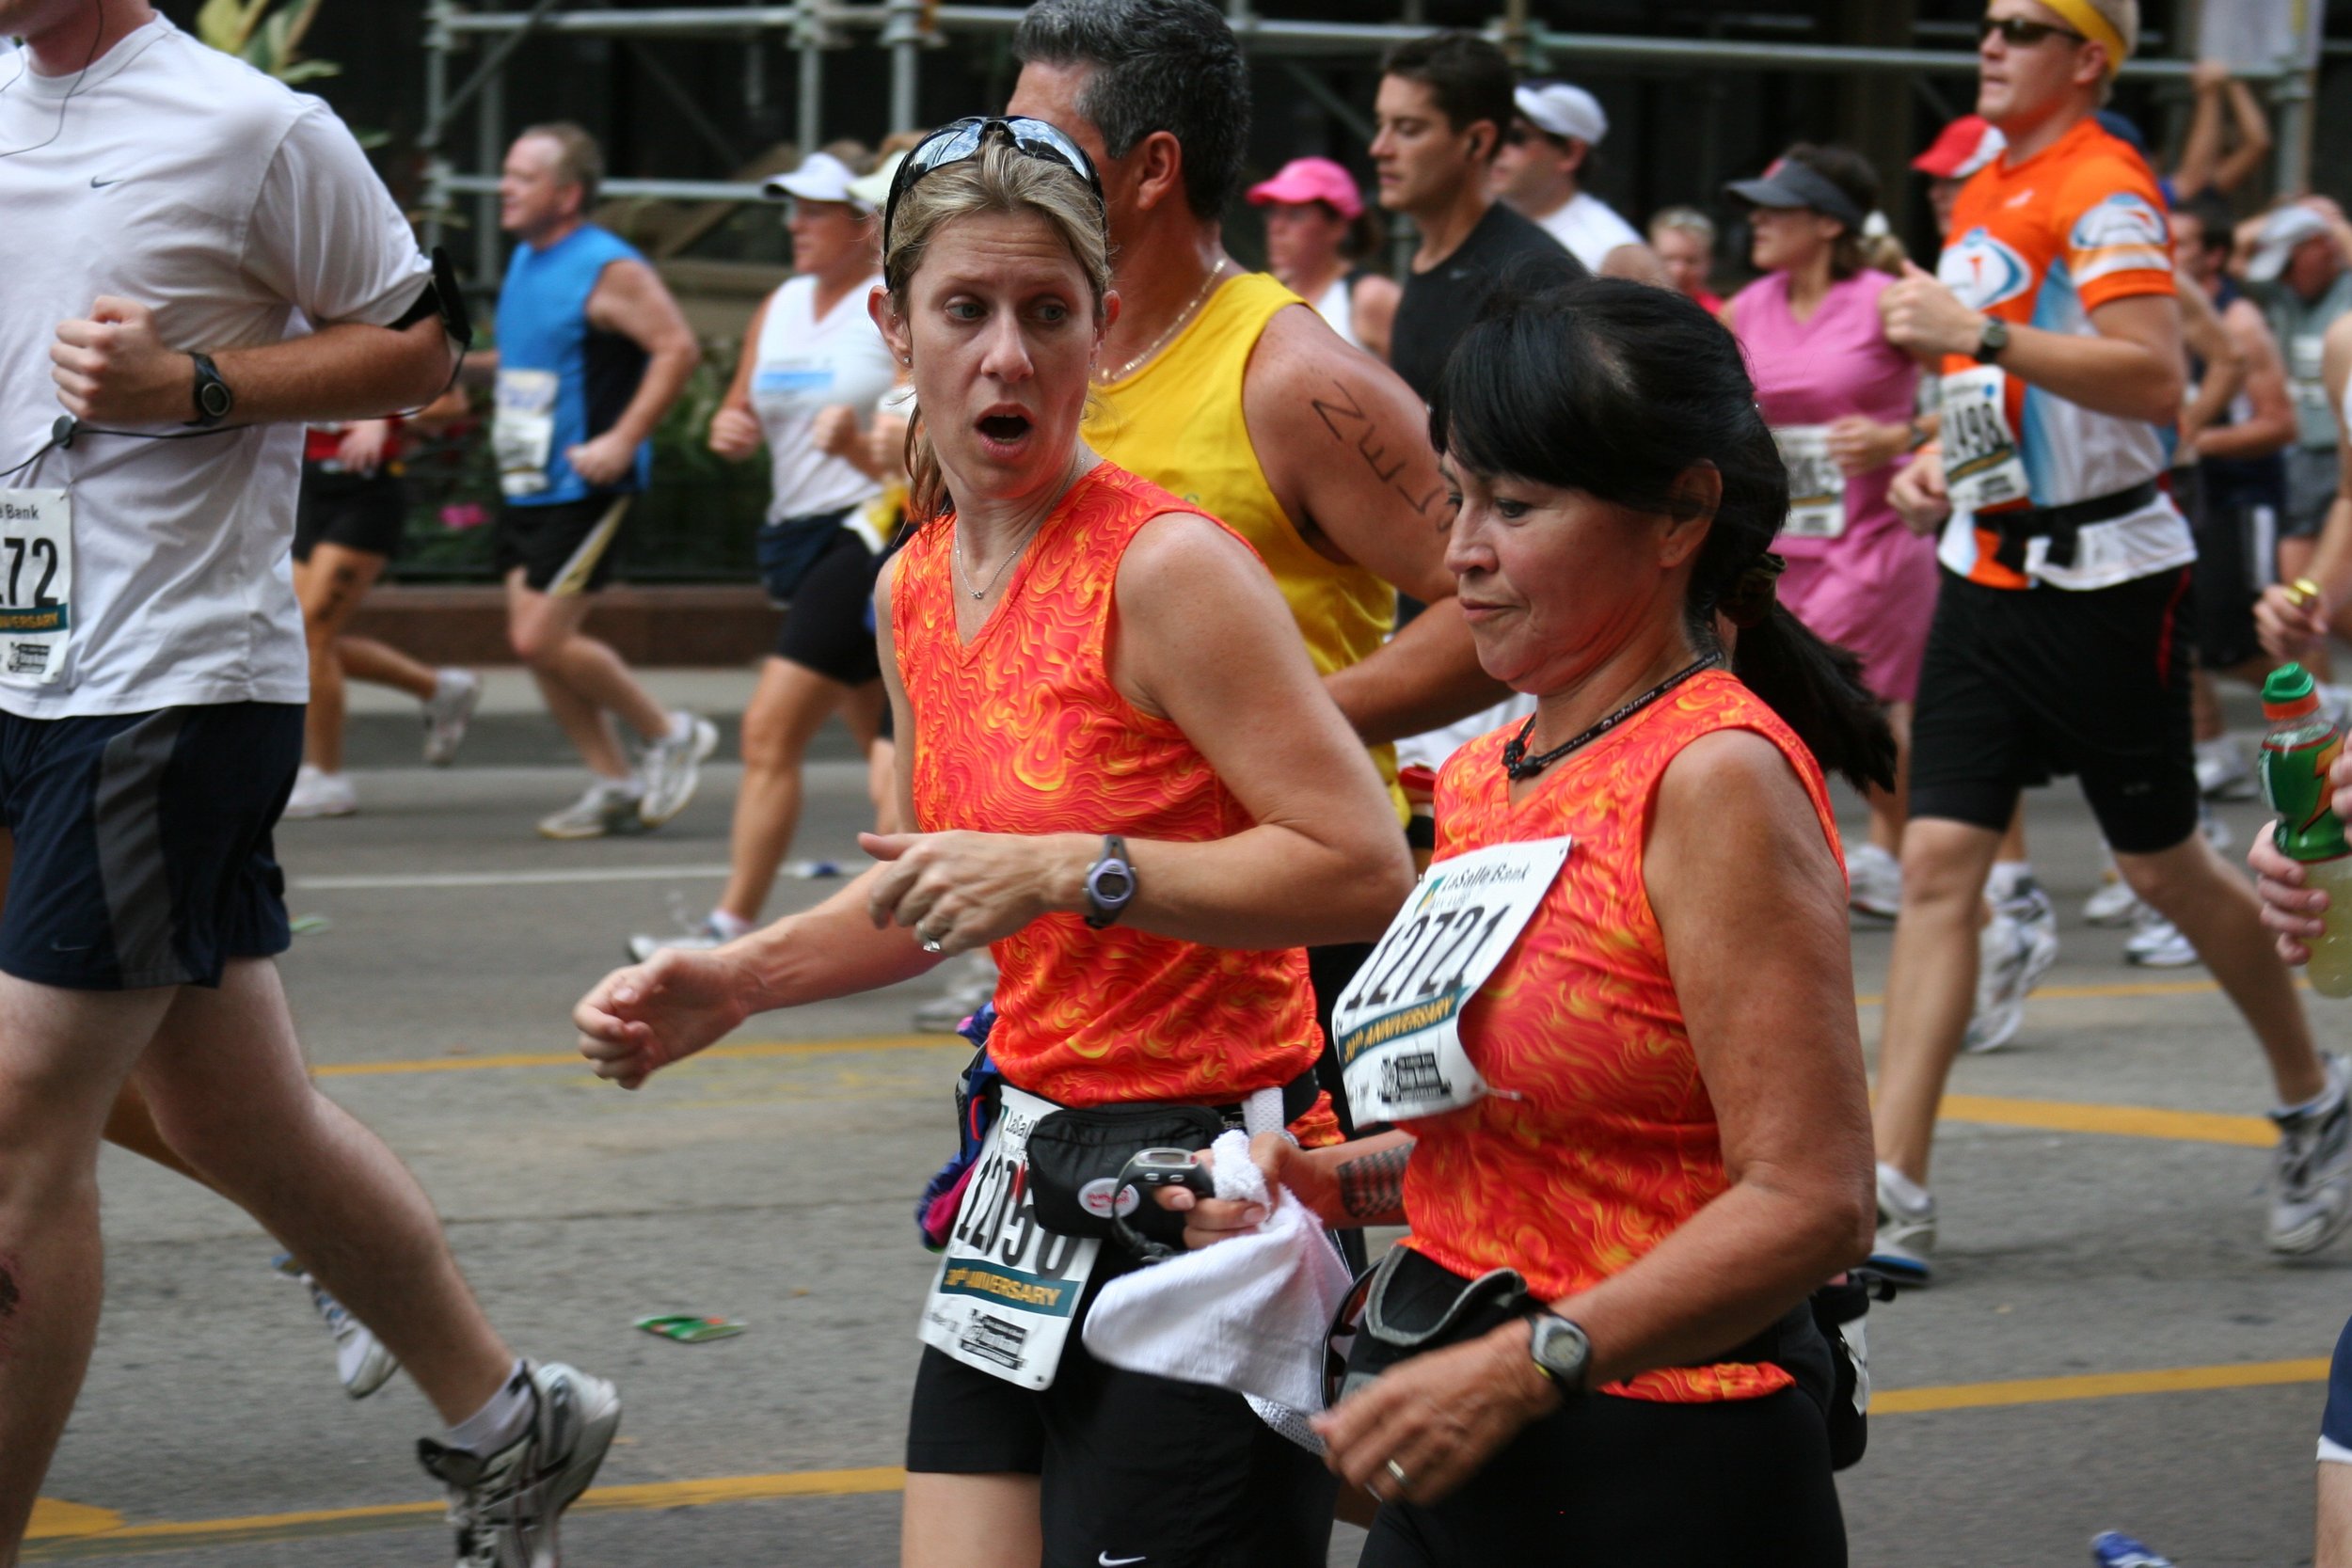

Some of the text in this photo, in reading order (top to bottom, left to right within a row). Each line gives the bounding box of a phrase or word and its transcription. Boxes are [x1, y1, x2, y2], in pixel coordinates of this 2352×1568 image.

[6, 503, 40, 520] Bank
[0, 537, 58, 608] 72
[1613, 690, 1656, 722] phiten
[1442, 860, 1532, 892] LaSalle Bank
[1345, 904, 1511, 1011] 12721
[1363, 995, 1455, 1050] ANNIVERSARY
[1006, 1110, 1039, 1140] LaSall
